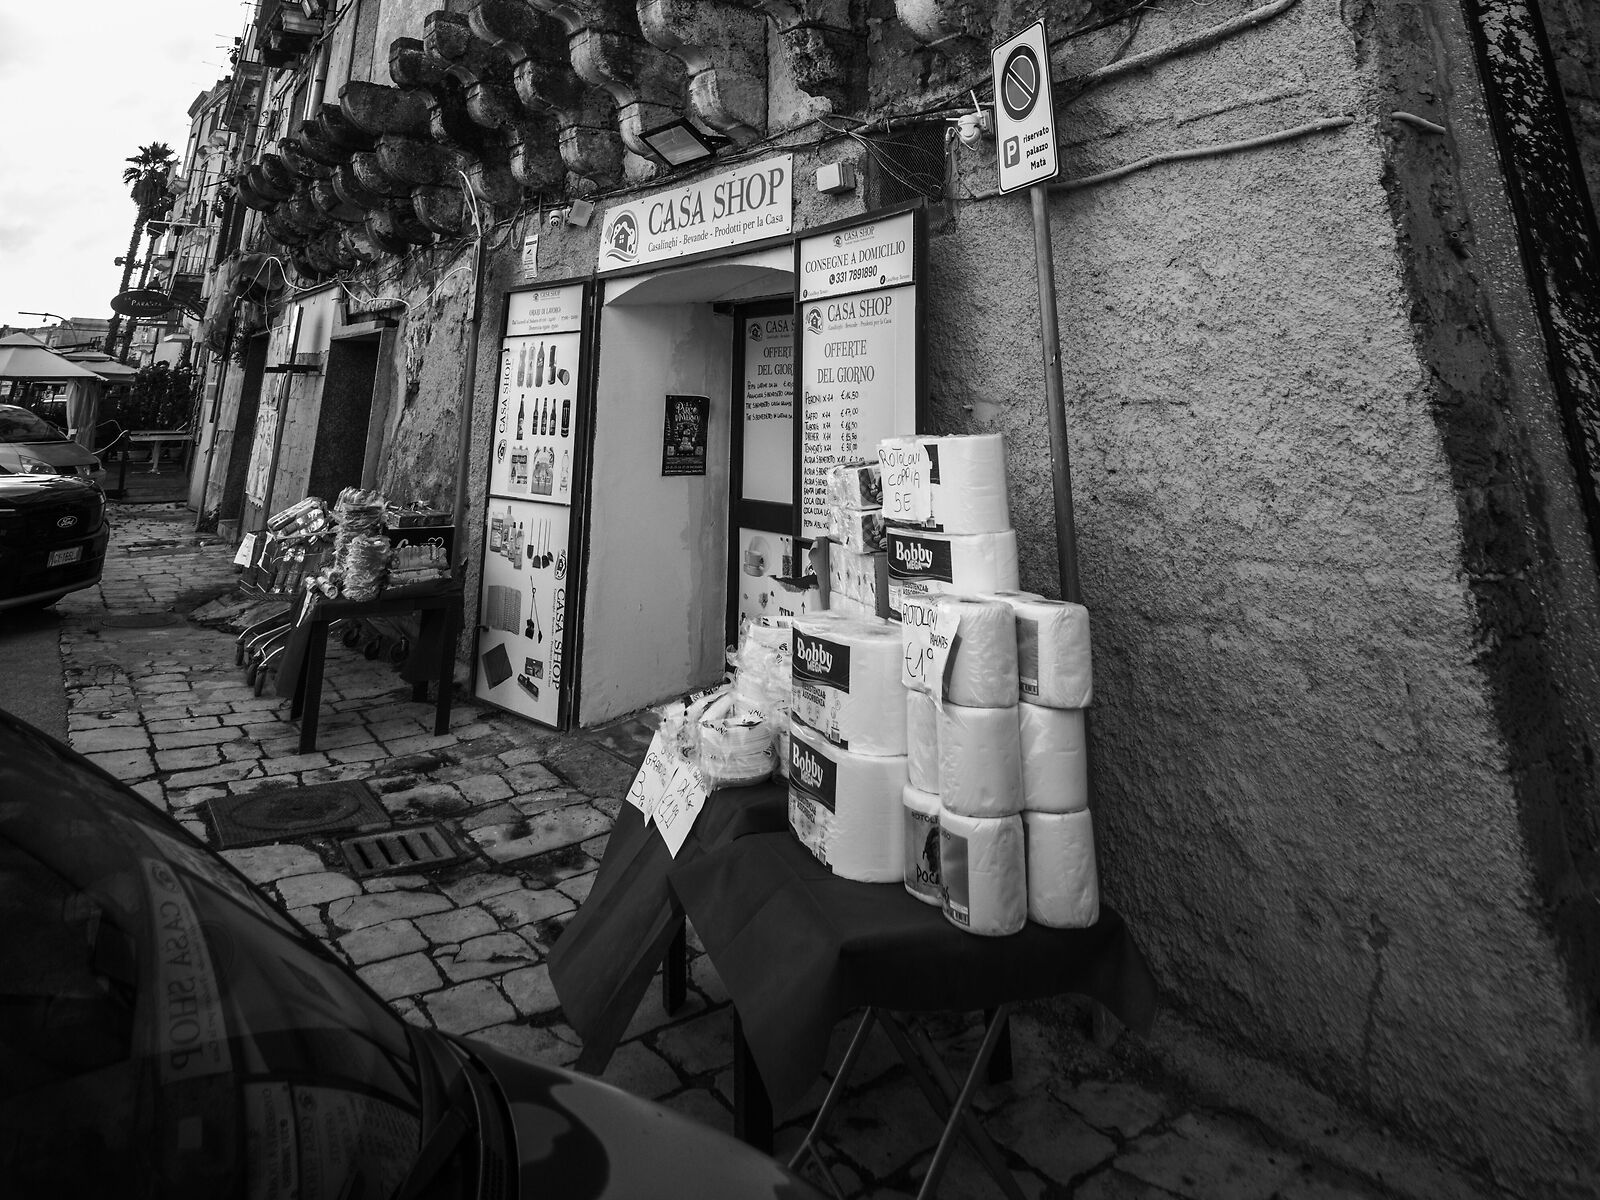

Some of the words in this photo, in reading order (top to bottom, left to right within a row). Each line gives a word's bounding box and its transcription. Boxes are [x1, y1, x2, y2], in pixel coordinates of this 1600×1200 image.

[1023, 126, 1049, 143] riservato
[1007, 140, 1017, 165] P
[1026, 142, 1049, 158] palazzo
[648, 190, 705, 236] CASA
[712, 167, 784, 222] SHOP
[648, 238, 678, 253] Casalinghi
[683, 232, 709, 246] Bevande
[714, 223, 742, 240] Prodotti
[742, 221, 756, 234] per
[757, 216, 764, 227] la
[765, 213, 784, 225] Casa
[844, 230, 859, 242] CASA
[859, 225, 875, 238] SHOP
[805, 253, 849, 274] CONSEGNE
[851, 252, 857, 264] A
[859, 240, 906, 263] DOMICILIO
[835, 271, 848, 284] 331
[849, 264, 878, 281] 7891890
[827, 302, 856, 323] CASA
[859, 296, 892, 317] SHOP
[766, 320, 789, 334] CASA
[763, 345, 793, 359] OFFERT
[824, 339, 867, 359] OFFERTE
[503, 358, 511, 395] SHOP
[758, 364, 772, 376] DEL
[774, 363, 794, 377] GIOR
[817, 368, 834, 384] DEL
[837, 365, 875, 385] GIORNO
[499, 398, 508, 434] CASA
[887, 466, 920, 488] COPPIA
[896, 540, 933, 569] Bobby
[907, 561, 923, 571] MEGA
[555, 588, 566, 633] CASA
[552, 640, 564, 690] SHOP
[796, 637, 833, 673] Bobby
[807, 661, 822, 674] MEGA
[792, 742, 823, 788] Bobby
